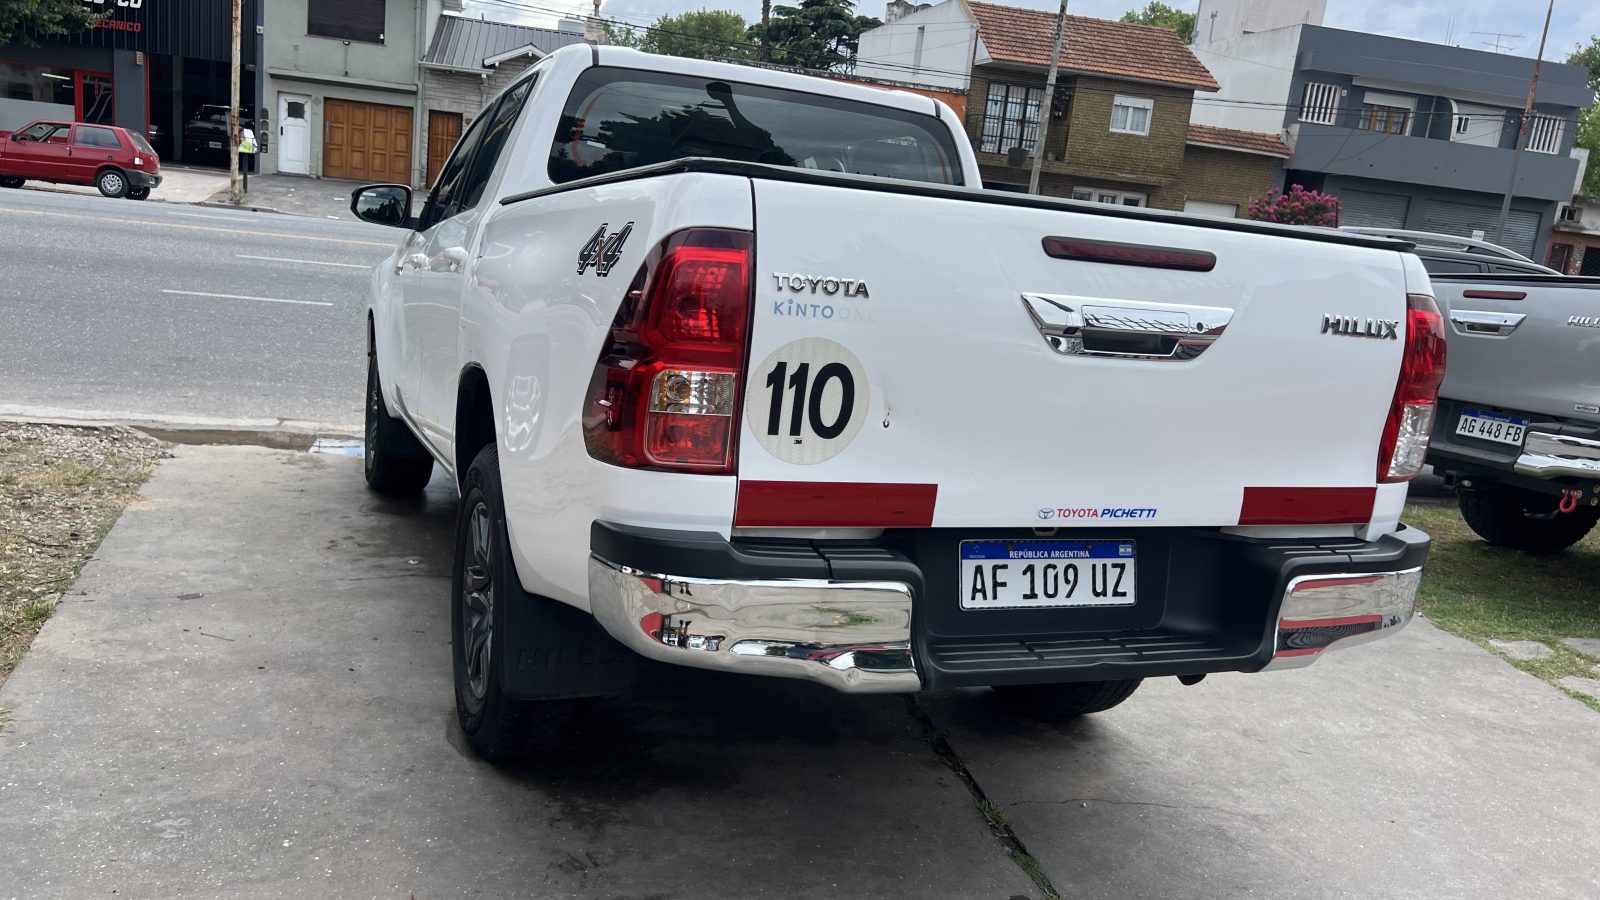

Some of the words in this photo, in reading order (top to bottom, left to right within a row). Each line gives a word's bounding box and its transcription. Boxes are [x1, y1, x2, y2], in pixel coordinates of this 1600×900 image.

[773, 271, 870, 299] TOYOTA
[1321, 312, 1399, 340] HILUX
[766, 361, 855, 440] 110
[1459, 417, 1477, 434] AG
[1478, 420, 1503, 439] 448
[1504, 425, 1523, 442] FB
[1057, 507, 1099, 518] TOYOTA
[1100, 507, 1158, 518] PICHETTI
[1009, 548, 1049, 559] REPÚBLICA
[1050, 550, 1090, 559] ARGENTINA
[970, 563, 1009, 601] AF
[1021, 562, 1080, 600] 109
[1091, 562, 1128, 598] UZ
